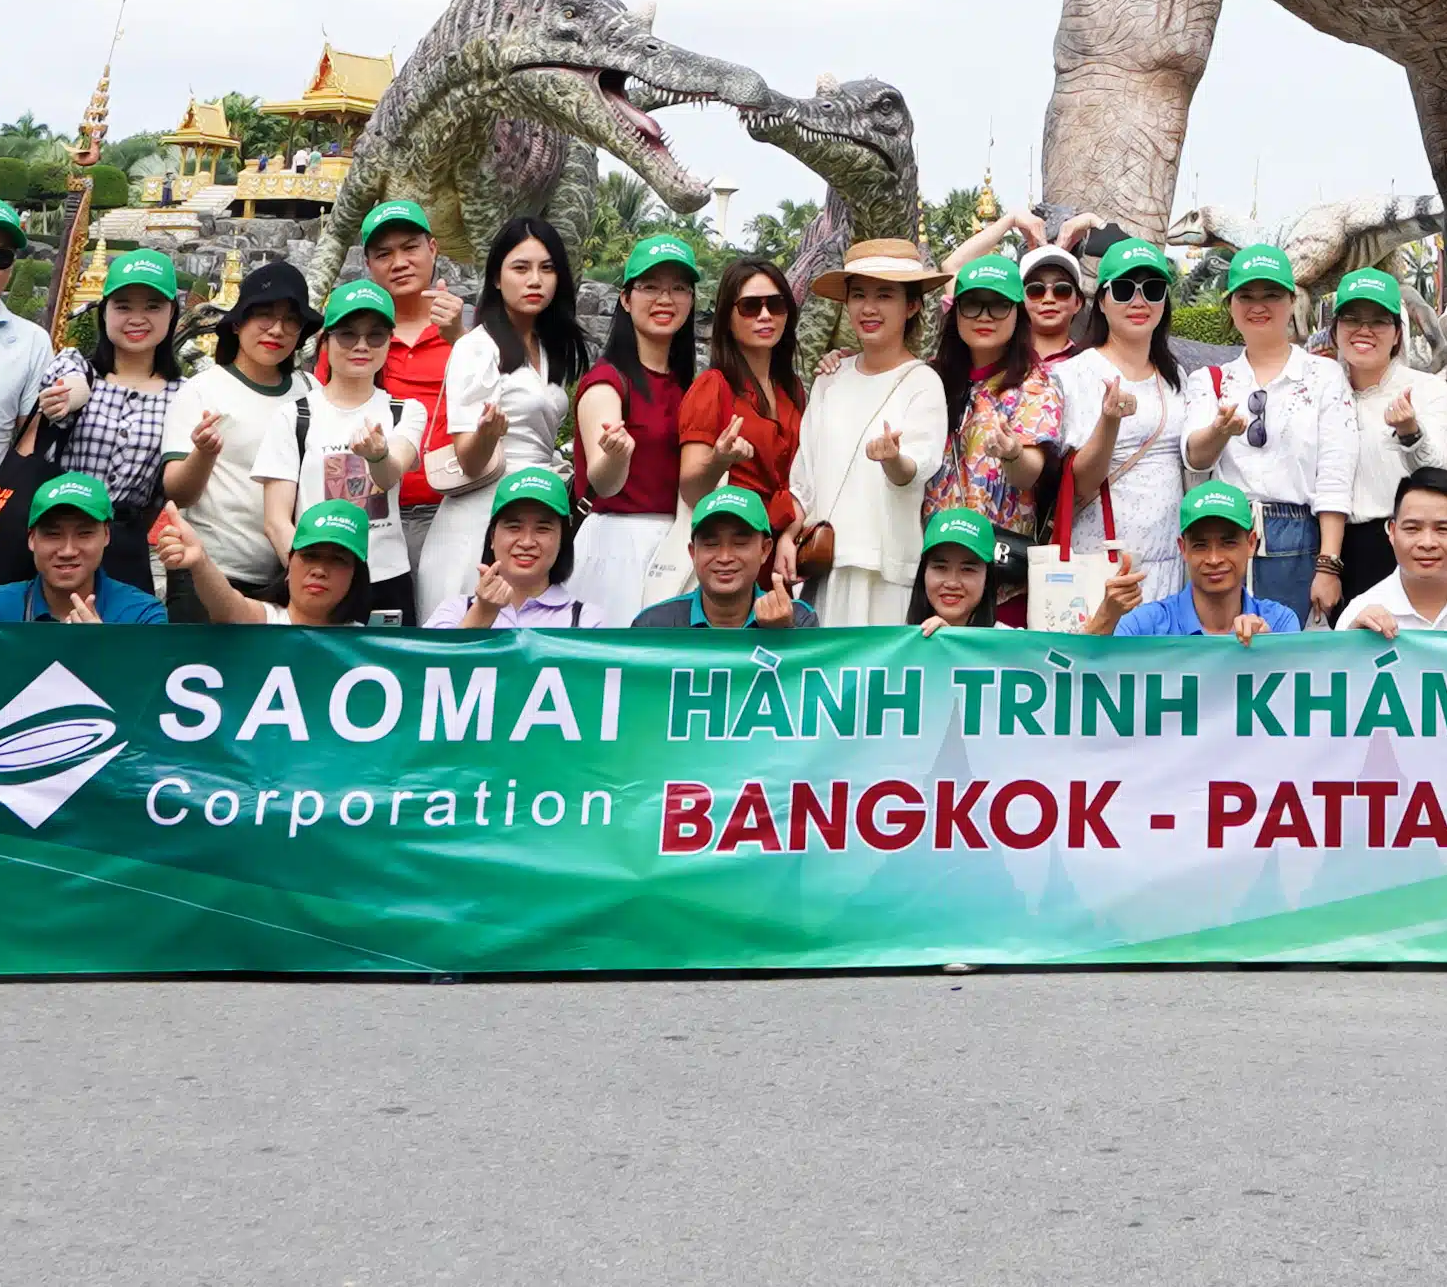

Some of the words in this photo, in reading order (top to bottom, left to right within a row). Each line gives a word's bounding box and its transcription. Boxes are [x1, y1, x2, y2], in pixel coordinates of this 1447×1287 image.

[159, 664, 622, 742] SAOMAI
[667, 645, 924, 741] HÀNH
[952, 648, 1200, 739] TRÌNH
[147, 777, 613, 838] Corporation
[660, 779, 1123, 856] BANGKOK
